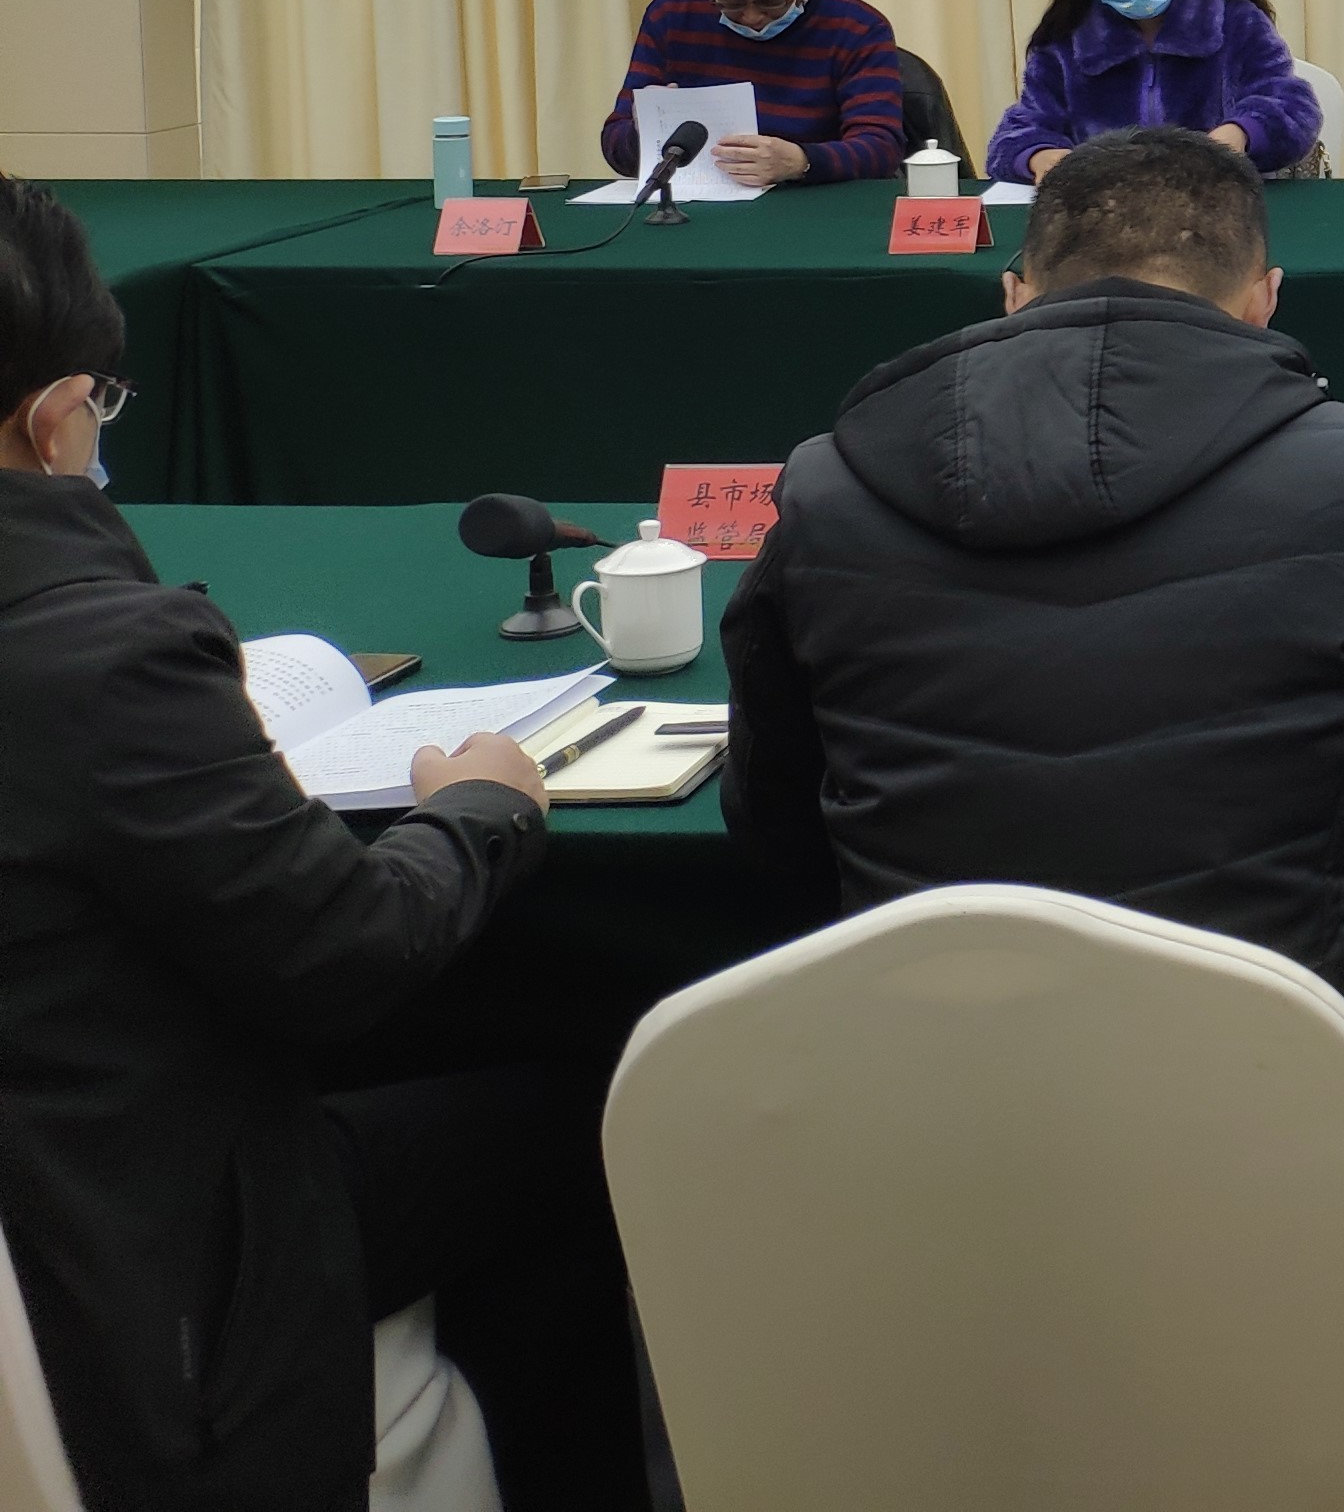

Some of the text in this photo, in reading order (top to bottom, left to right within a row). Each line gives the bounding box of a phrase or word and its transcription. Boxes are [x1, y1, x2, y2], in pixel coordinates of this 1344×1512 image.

[903, 214, 971, 237] 姜建军
[687, 478, 776, 511] 县市场
